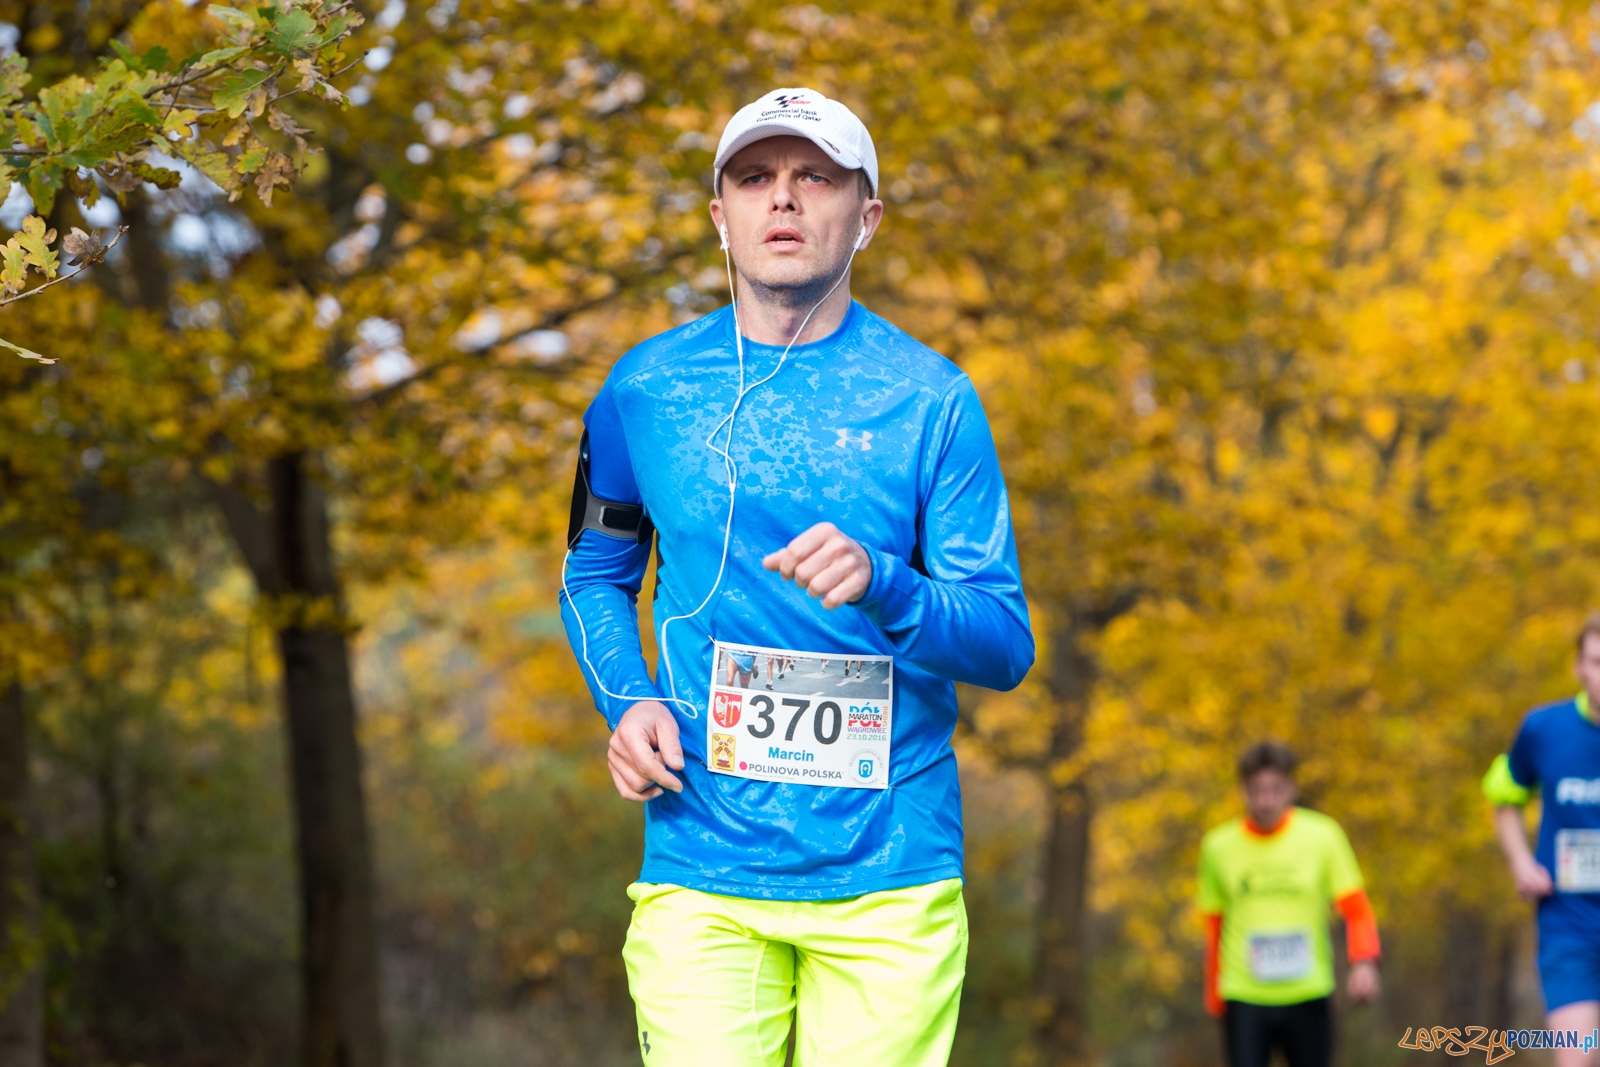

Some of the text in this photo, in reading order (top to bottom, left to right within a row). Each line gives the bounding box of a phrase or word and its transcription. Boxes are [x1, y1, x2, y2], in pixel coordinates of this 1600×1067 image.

[761, 108, 818, 117] Commercial bank
[756, 114, 777, 122] Grand
[802, 114, 822, 122] Qatar
[746, 694, 843, 745] 370
[848, 713, 882, 721] MARATON
[847, 734, 887, 742] 23.10.2016
[768, 746, 814, 762] Marcin
[748, 763, 800, 776] POLINOVA
[802, 769, 842, 780] POLSKA
